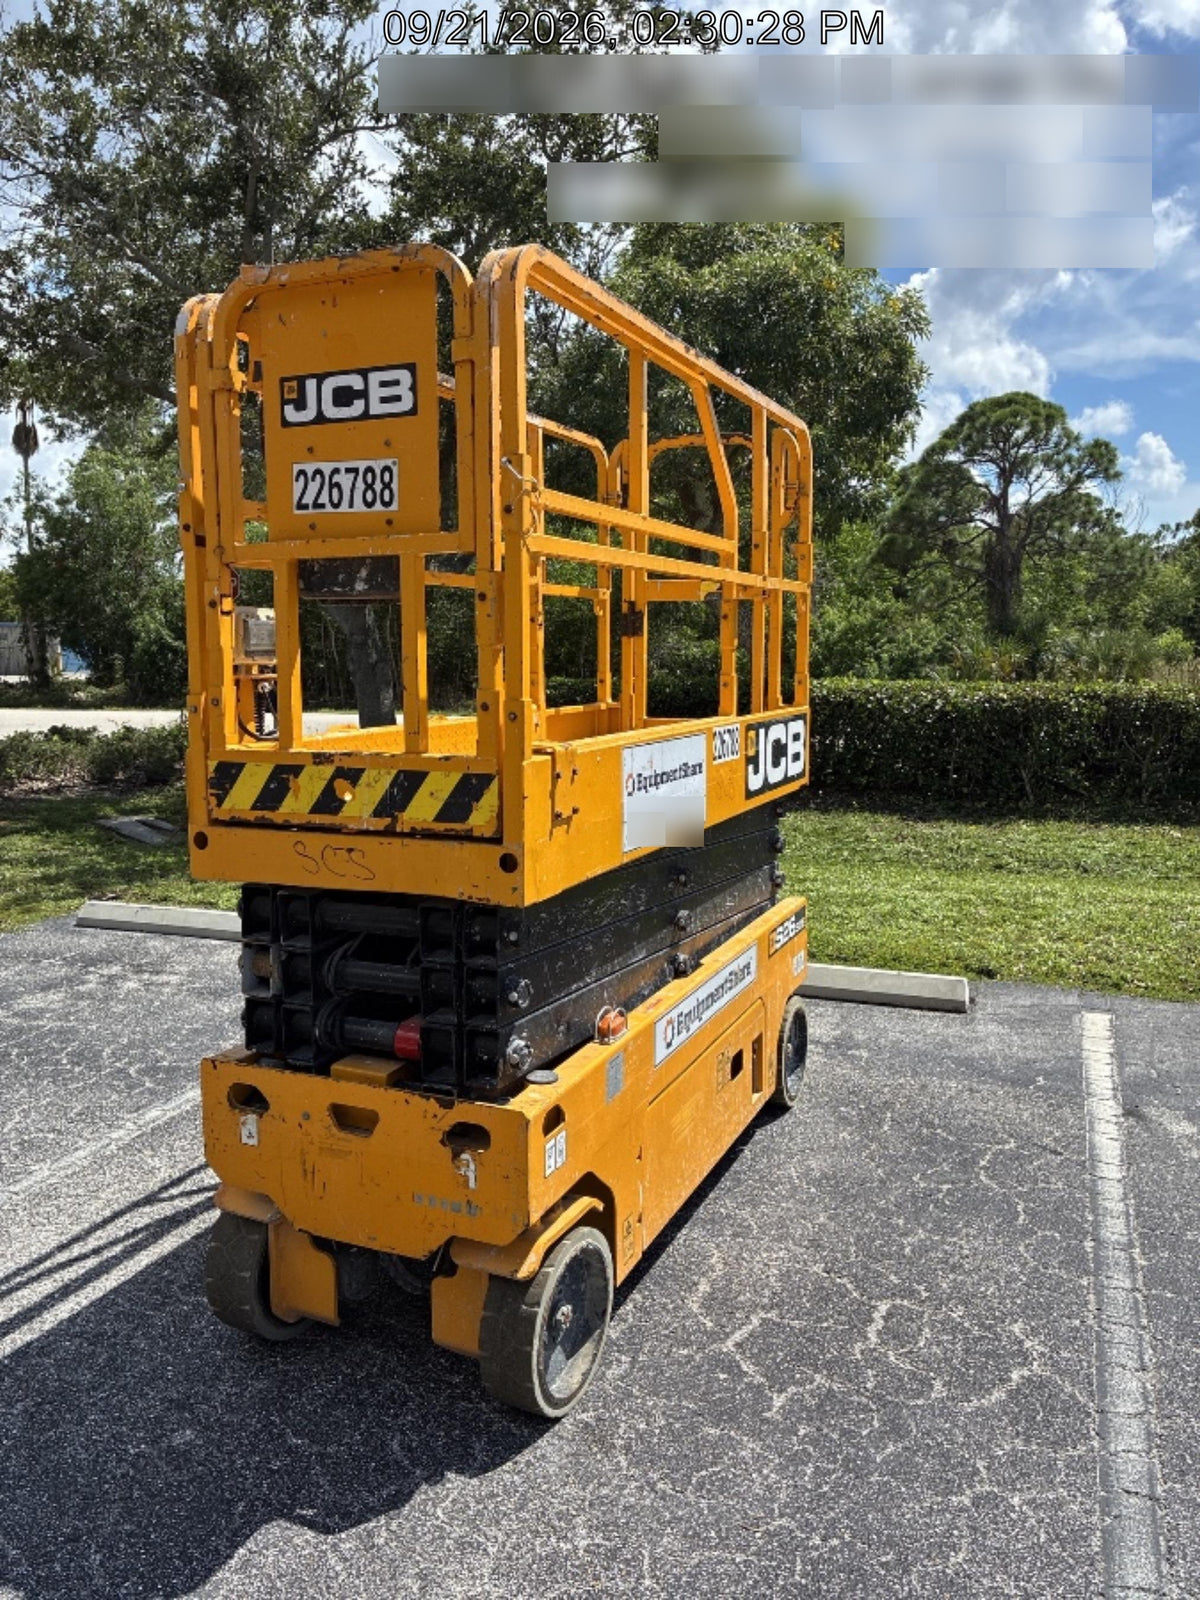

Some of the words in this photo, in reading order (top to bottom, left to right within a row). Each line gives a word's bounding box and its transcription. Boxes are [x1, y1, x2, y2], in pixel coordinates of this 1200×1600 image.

[283, 368, 415, 423] JCB
[294, 465, 395, 511] 226788
[636, 762, 703, 793] EquipmentShare
[748, 719, 806, 791] JCB
[677, 961, 751, 1036] EquipmentShare
